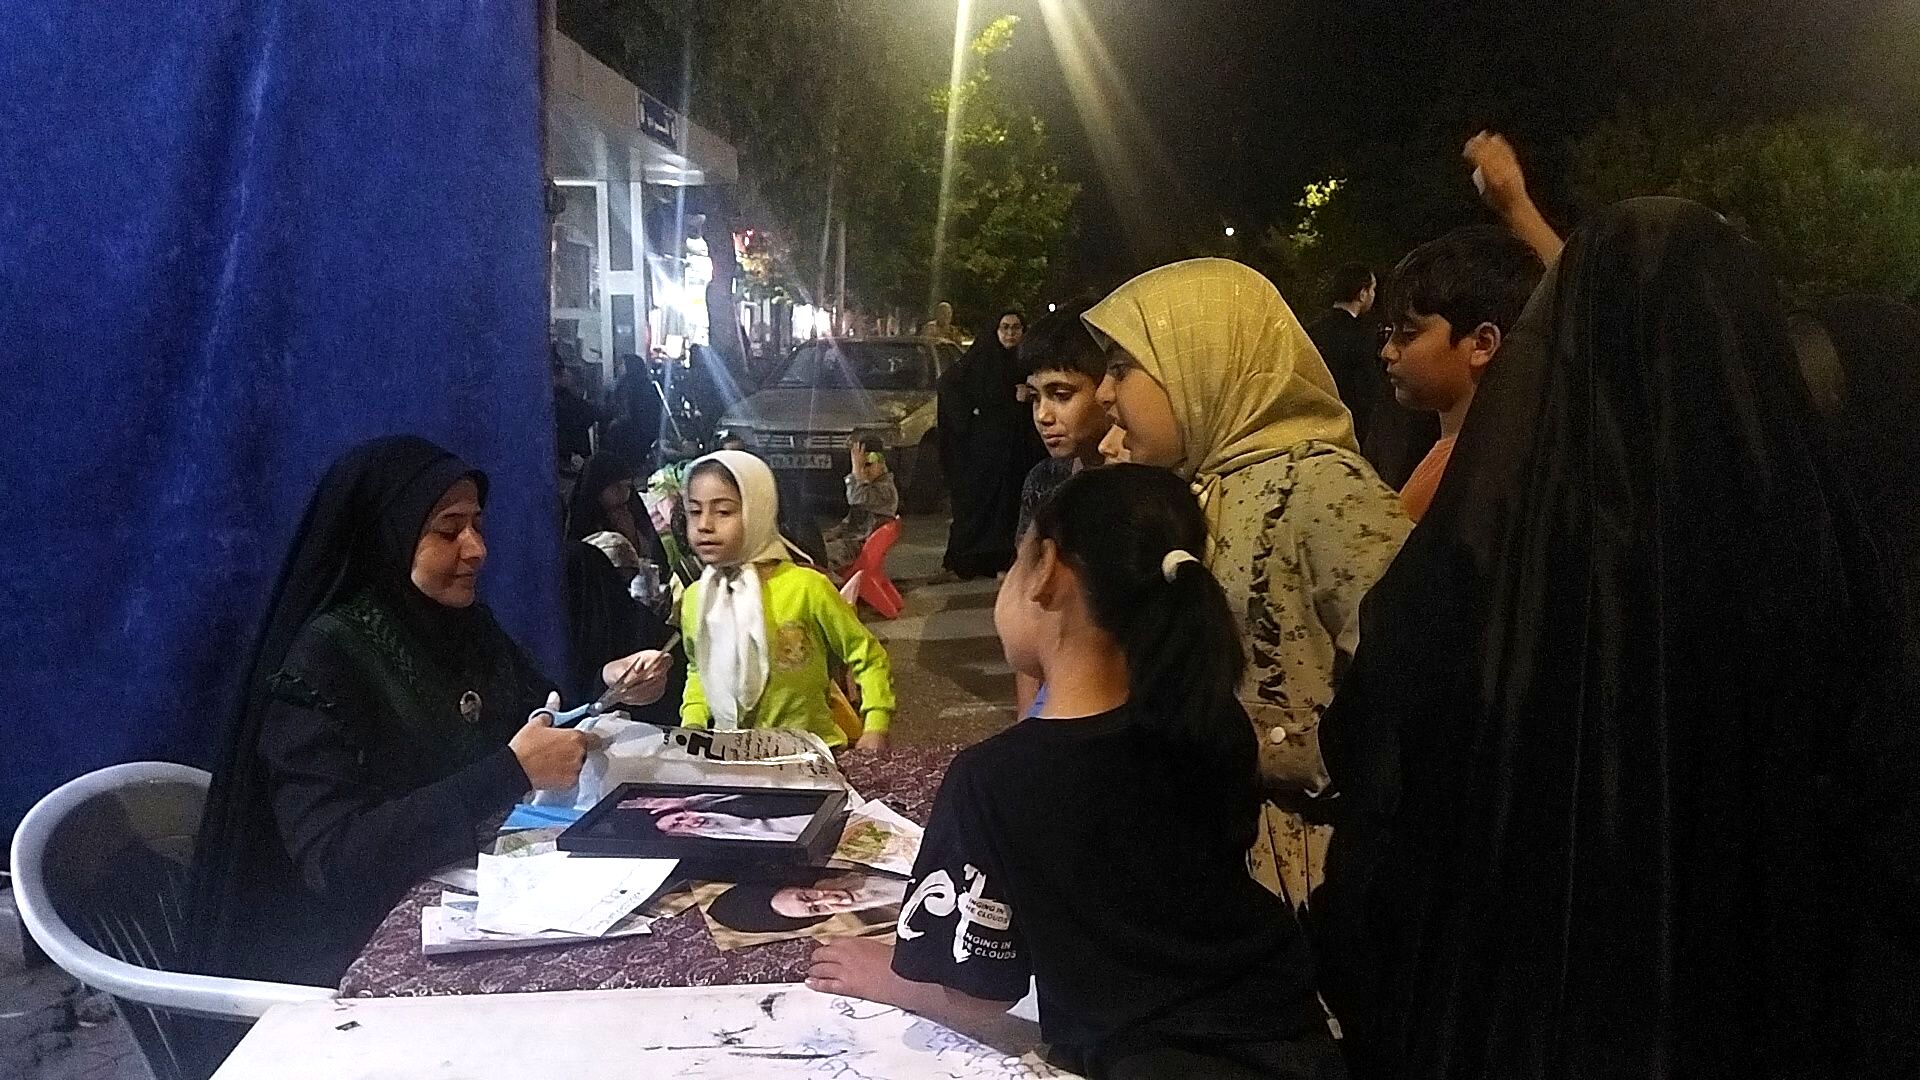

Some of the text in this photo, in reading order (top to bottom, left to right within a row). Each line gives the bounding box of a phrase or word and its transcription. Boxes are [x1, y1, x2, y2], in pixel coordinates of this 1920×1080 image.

[977, 911, 1008, 923] CLOUDS
[1001, 941, 1011, 950] IN
[975, 947, 1017, 959] CLOUDS
